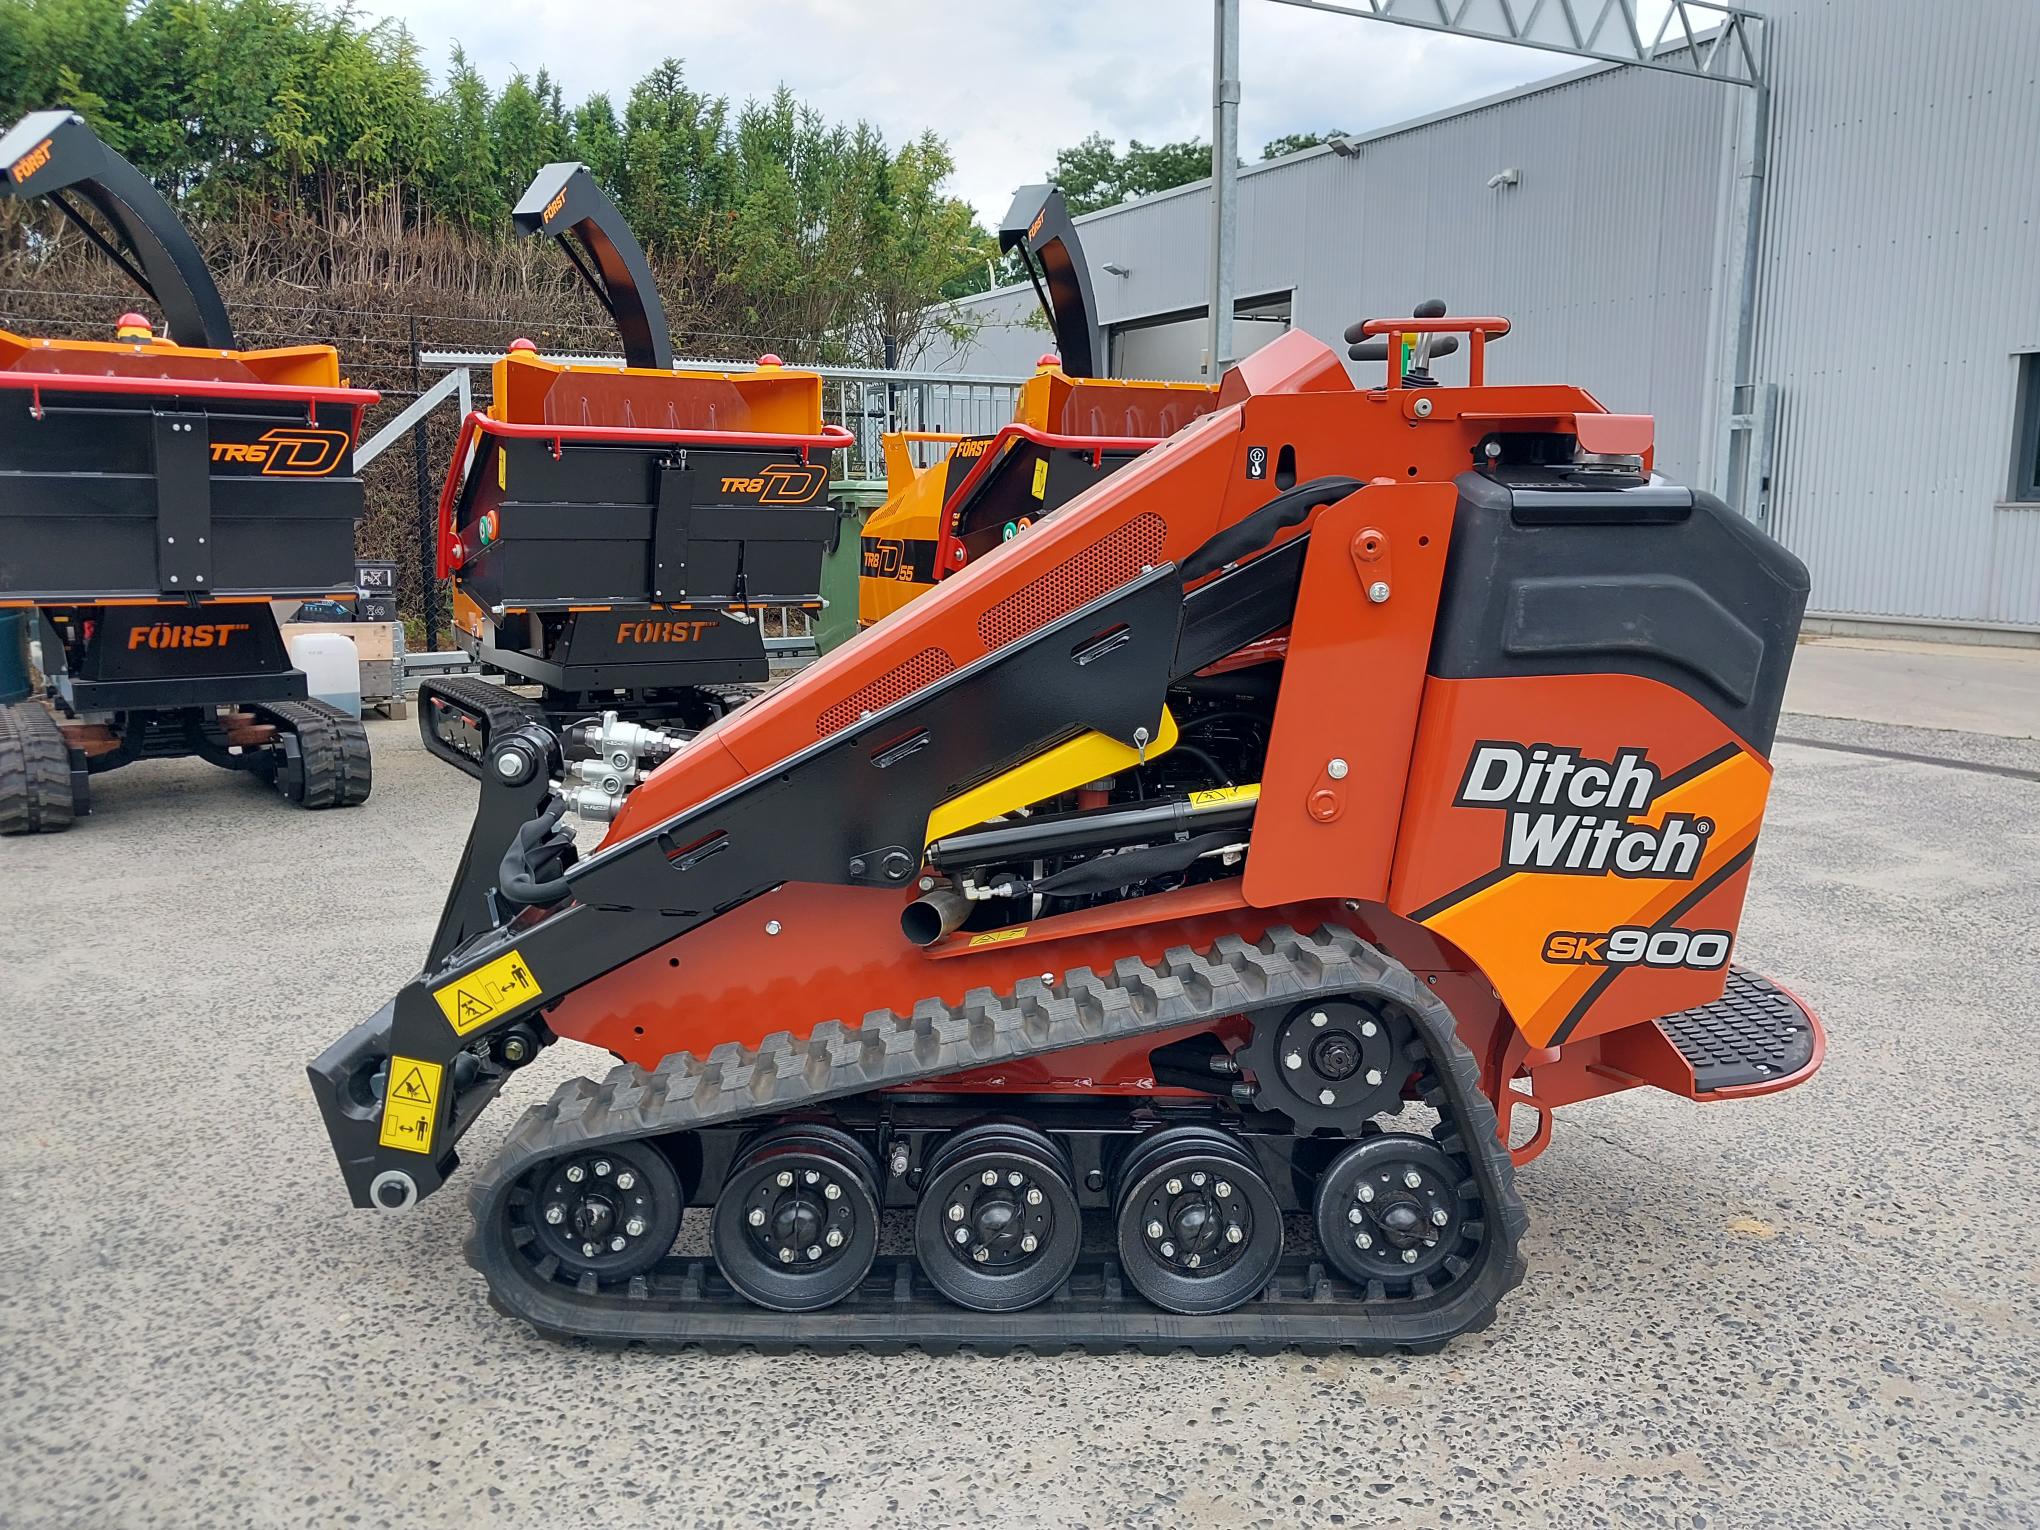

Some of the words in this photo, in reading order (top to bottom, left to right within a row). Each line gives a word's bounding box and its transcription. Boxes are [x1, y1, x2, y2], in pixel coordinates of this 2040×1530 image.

[11, 138, 53, 184] FÖRST
[543, 186, 567, 224] FÖRST
[956, 439, 994, 458] FÖRST
[127, 622, 249, 650] FÖRST
[616, 619, 719, 644] FÖRST
[1462, 747, 1654, 809] Ditch
[1546, 930, 1730, 967] SK900
